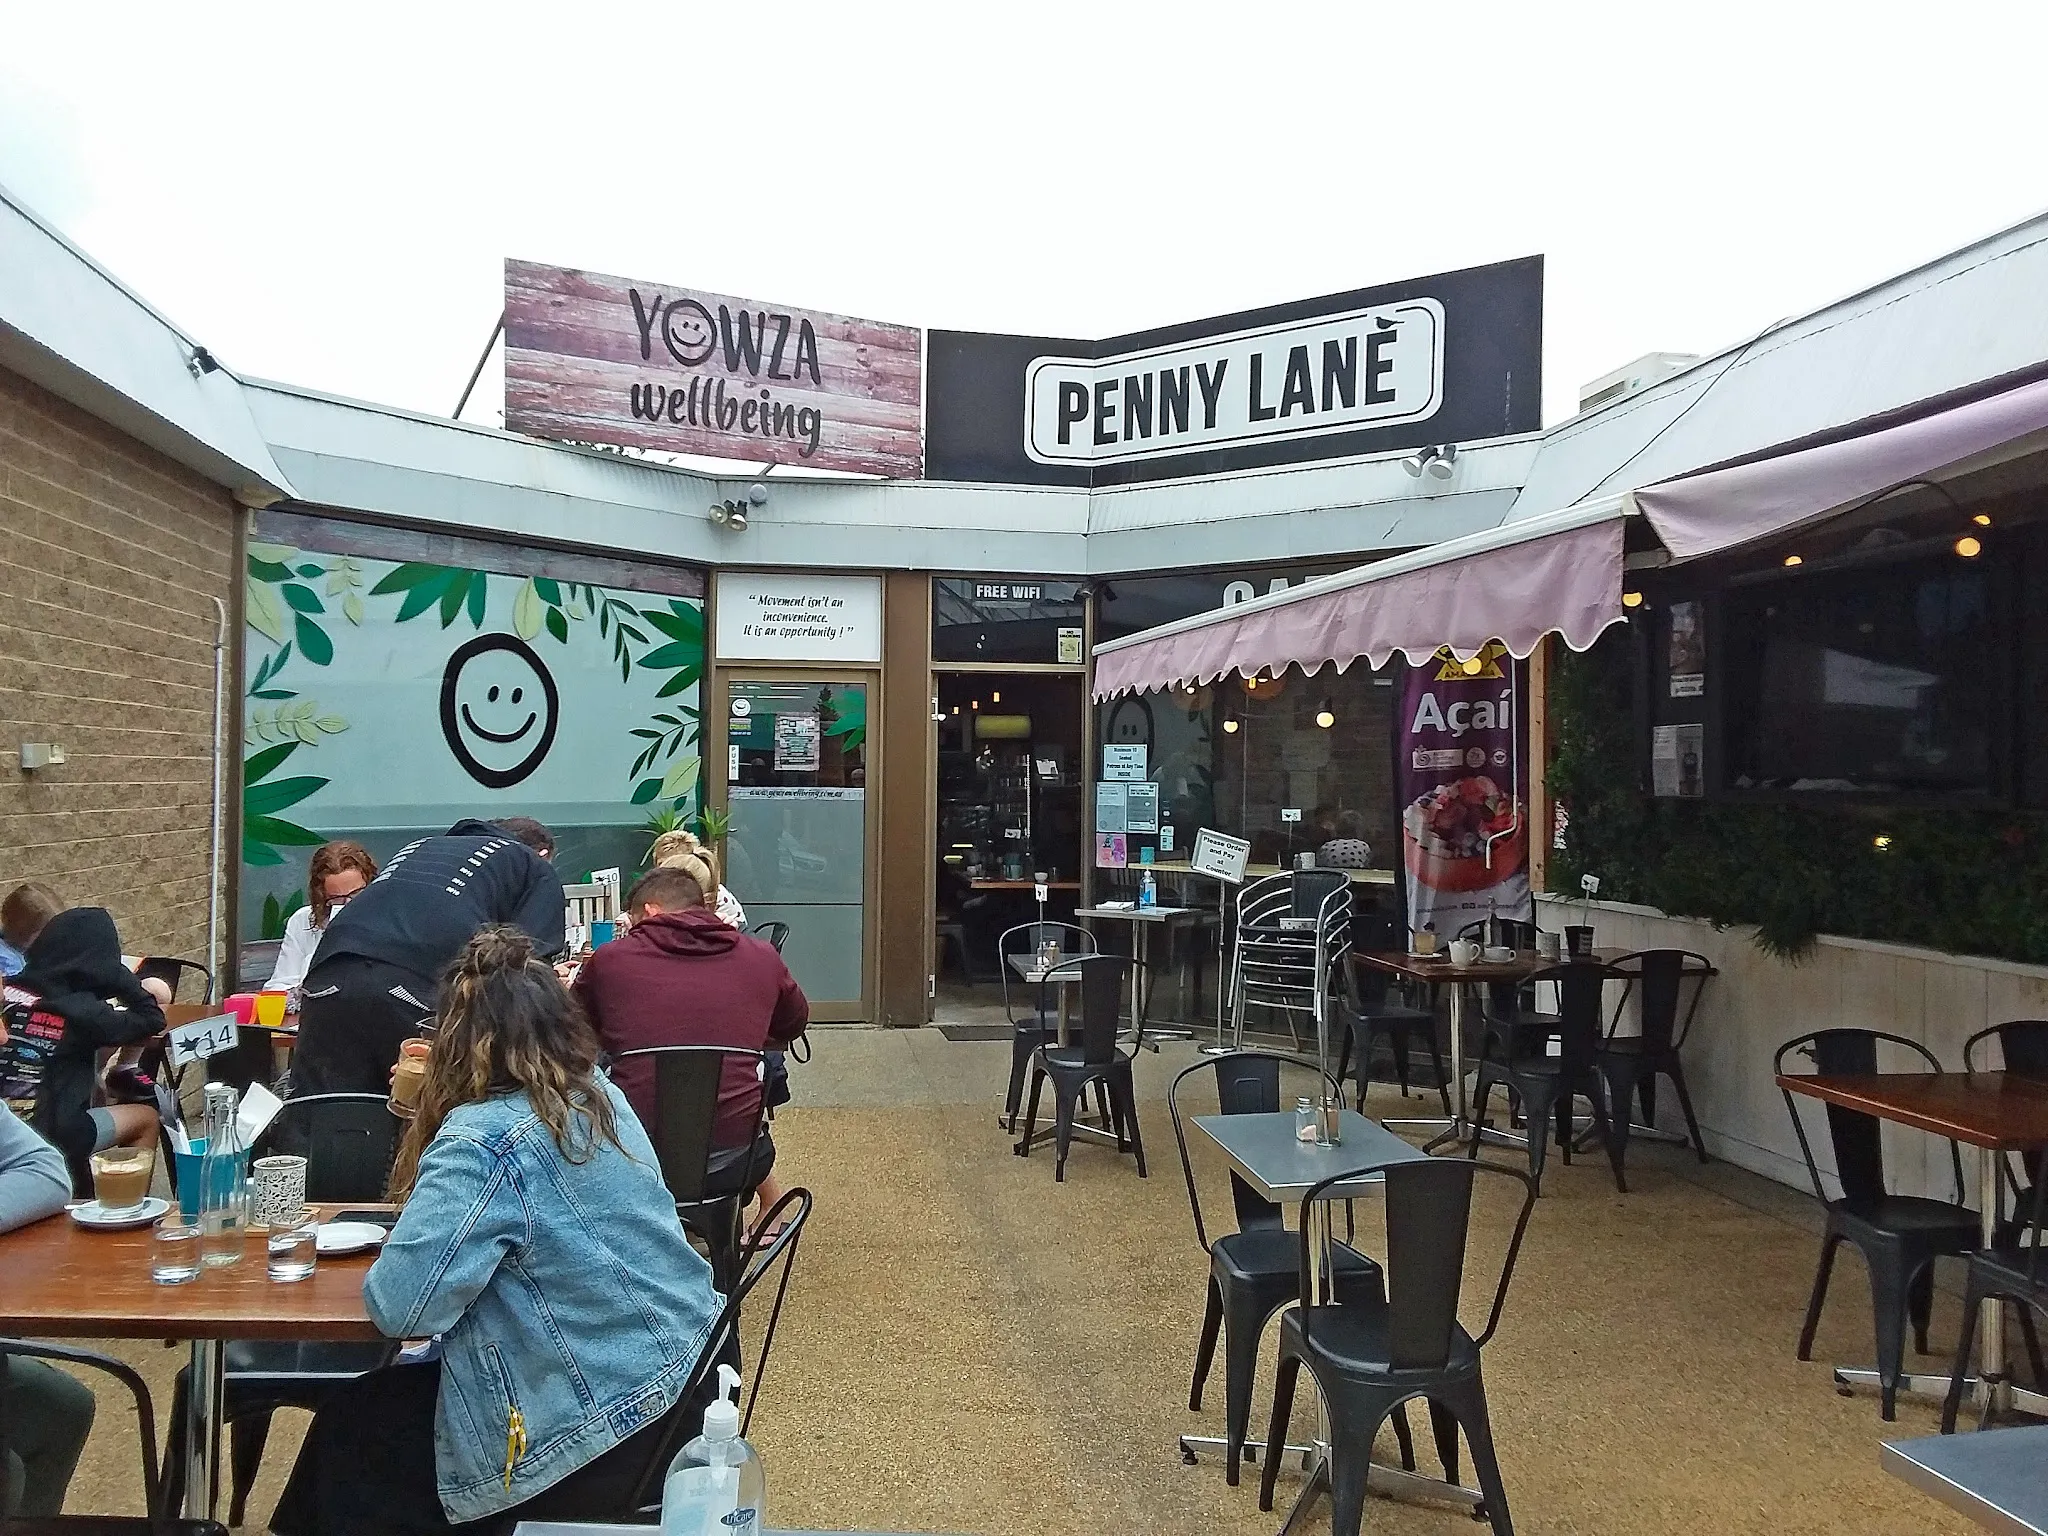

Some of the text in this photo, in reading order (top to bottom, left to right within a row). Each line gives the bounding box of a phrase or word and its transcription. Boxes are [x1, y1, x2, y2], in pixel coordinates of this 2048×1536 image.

[628, 288, 822, 385] YOWZA
[1056, 357, 1228, 446] PENNY
[629, 375, 822, 458] wellbeing
[976, 584, 1041, 600] FREE WIFI
[831, 599, 844, 608] an
[762, 610, 829, 623] inconvenience.
[743, 624, 752, 636] It
[754, 625, 763, 637] is
[764, 627, 777, 636] an
[1411, 688, 1512, 738] Açaí
[1203, 836, 1245, 853] Please Order
[1222, 851, 1235, 860] Pay
[1205, 864, 1232, 876] Counter
[203, 1024, 233, 1051] 14
